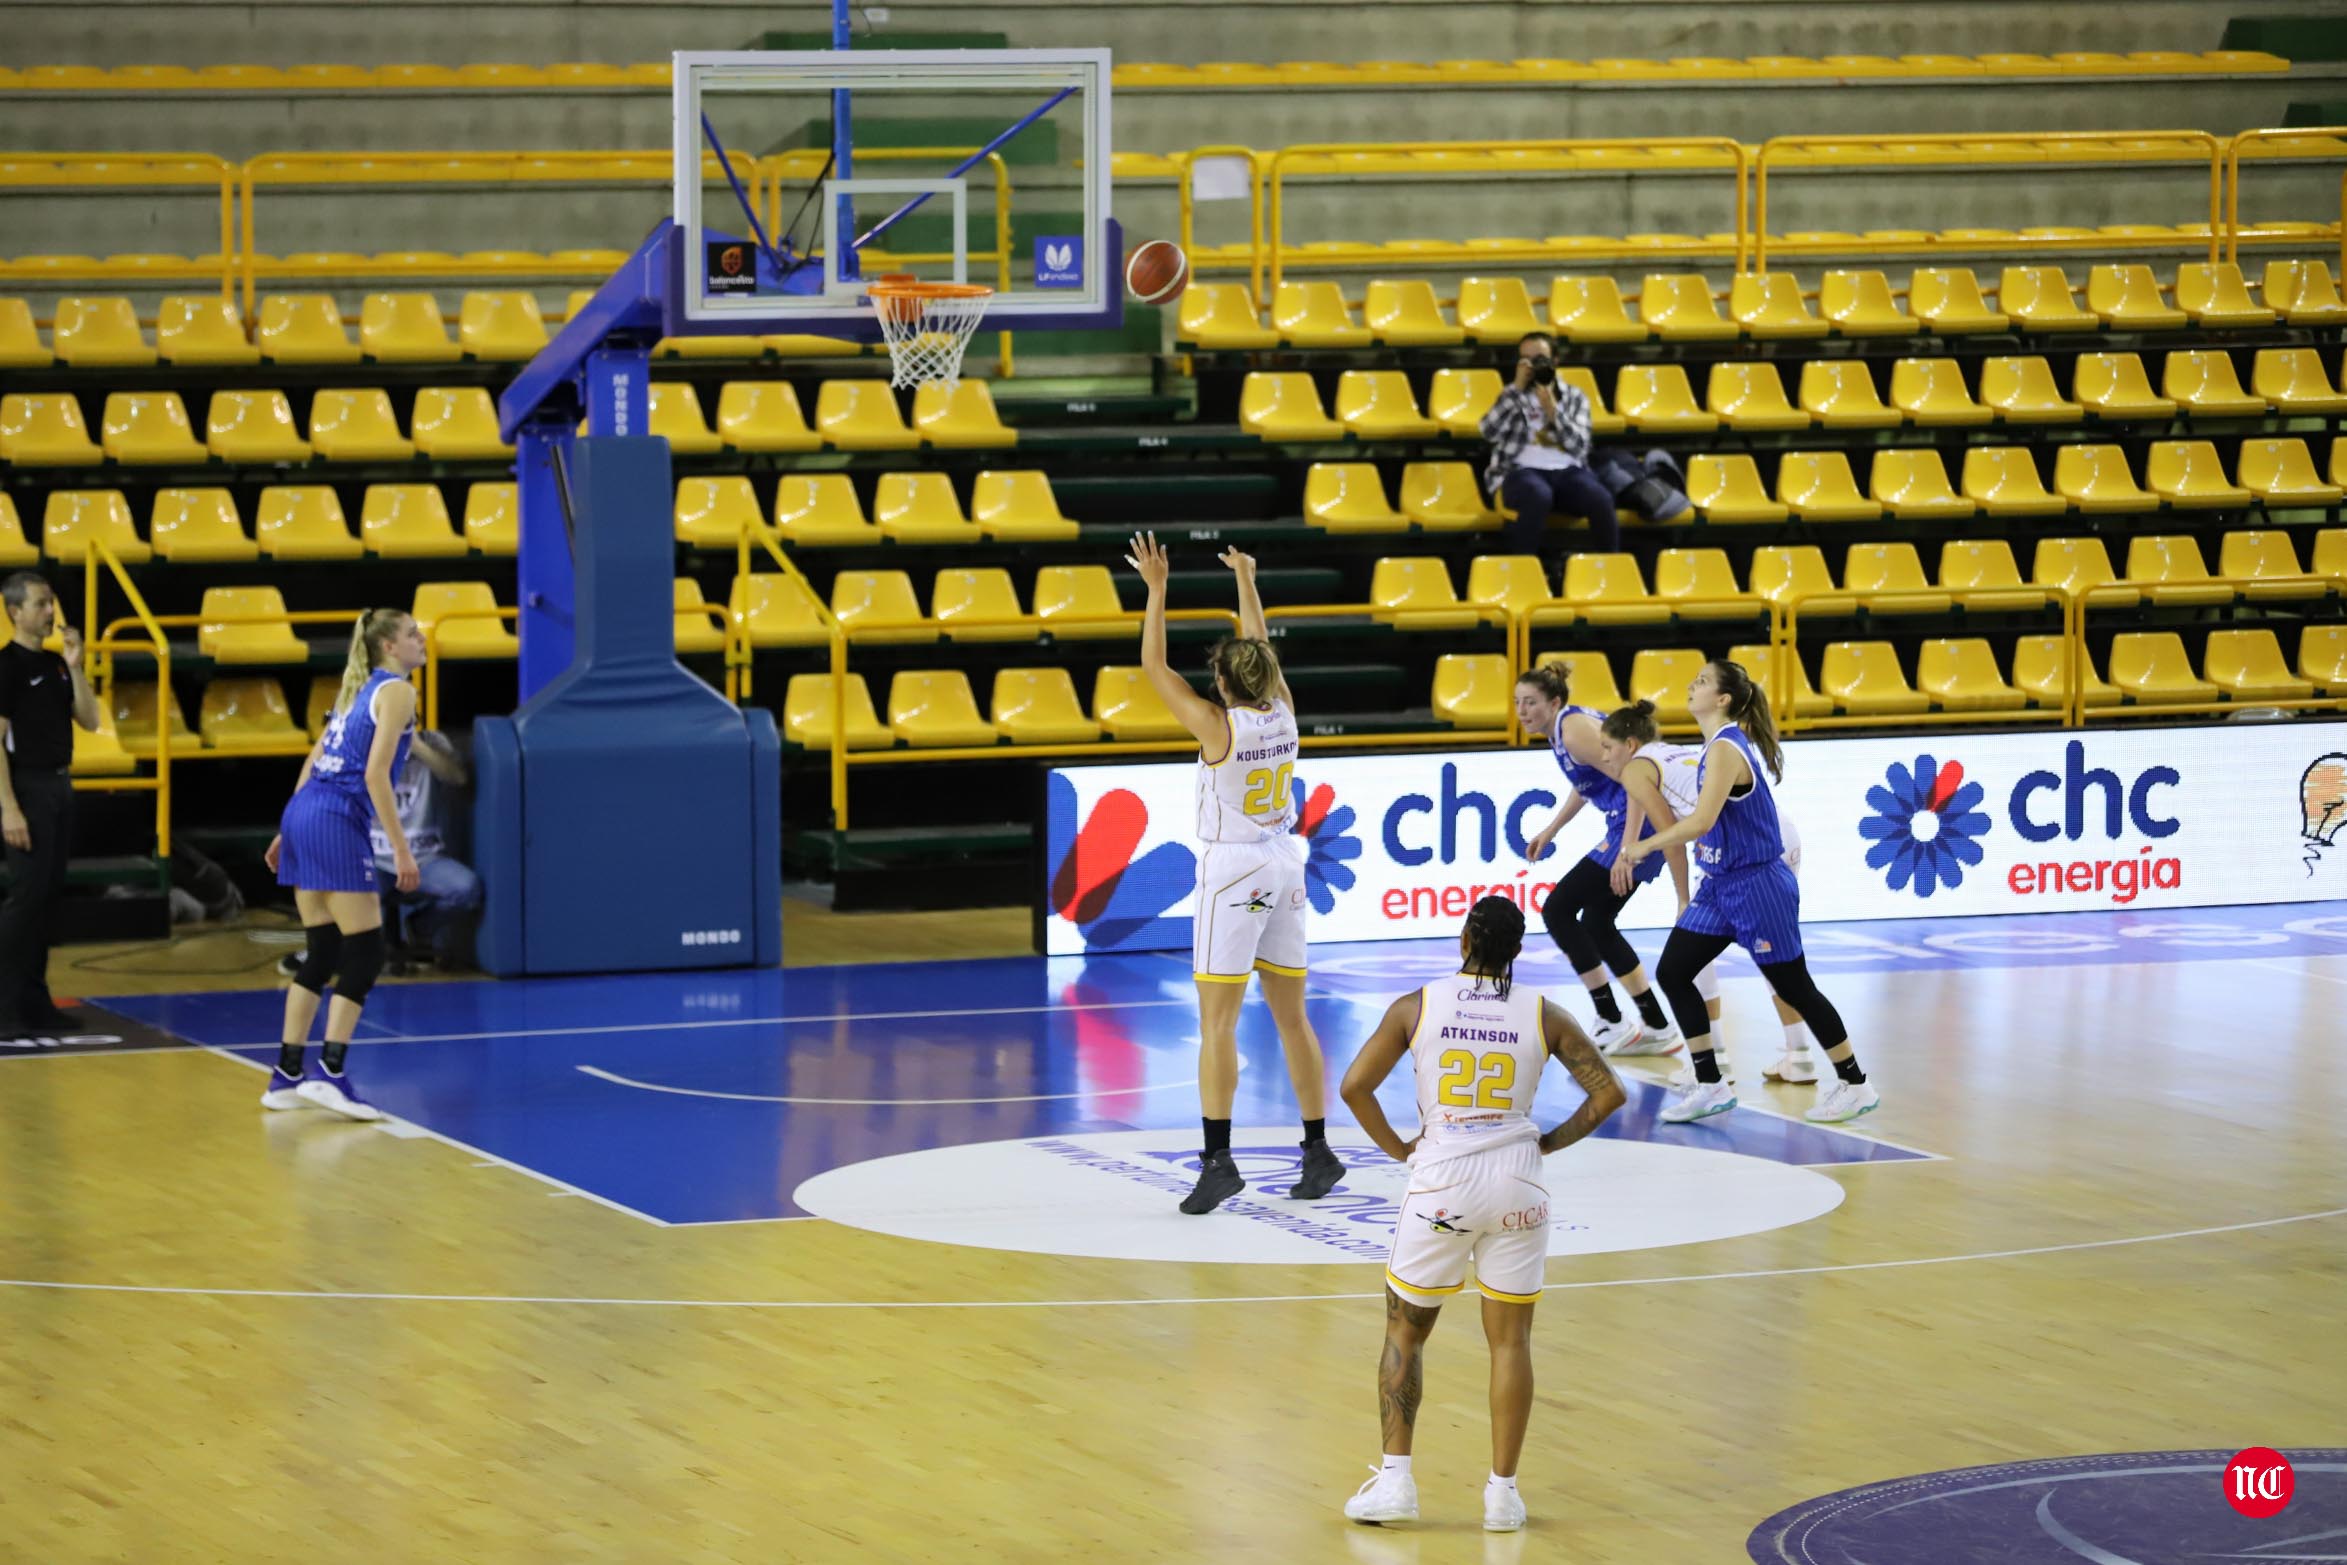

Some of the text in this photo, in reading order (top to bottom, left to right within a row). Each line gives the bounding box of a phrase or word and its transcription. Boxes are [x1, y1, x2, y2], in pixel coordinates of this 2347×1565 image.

[613, 373, 629, 437] MONDO
[1242, 760, 1295, 816] 20
[1382, 762, 1557, 866] chc
[2008, 740, 2180, 842] chc
[2008, 846, 2181, 904] energía
[681, 930, 741, 946] MONDO
[1440, 1026, 1518, 1044] ATKINSON
[1438, 1048, 1517, 1111] 22
